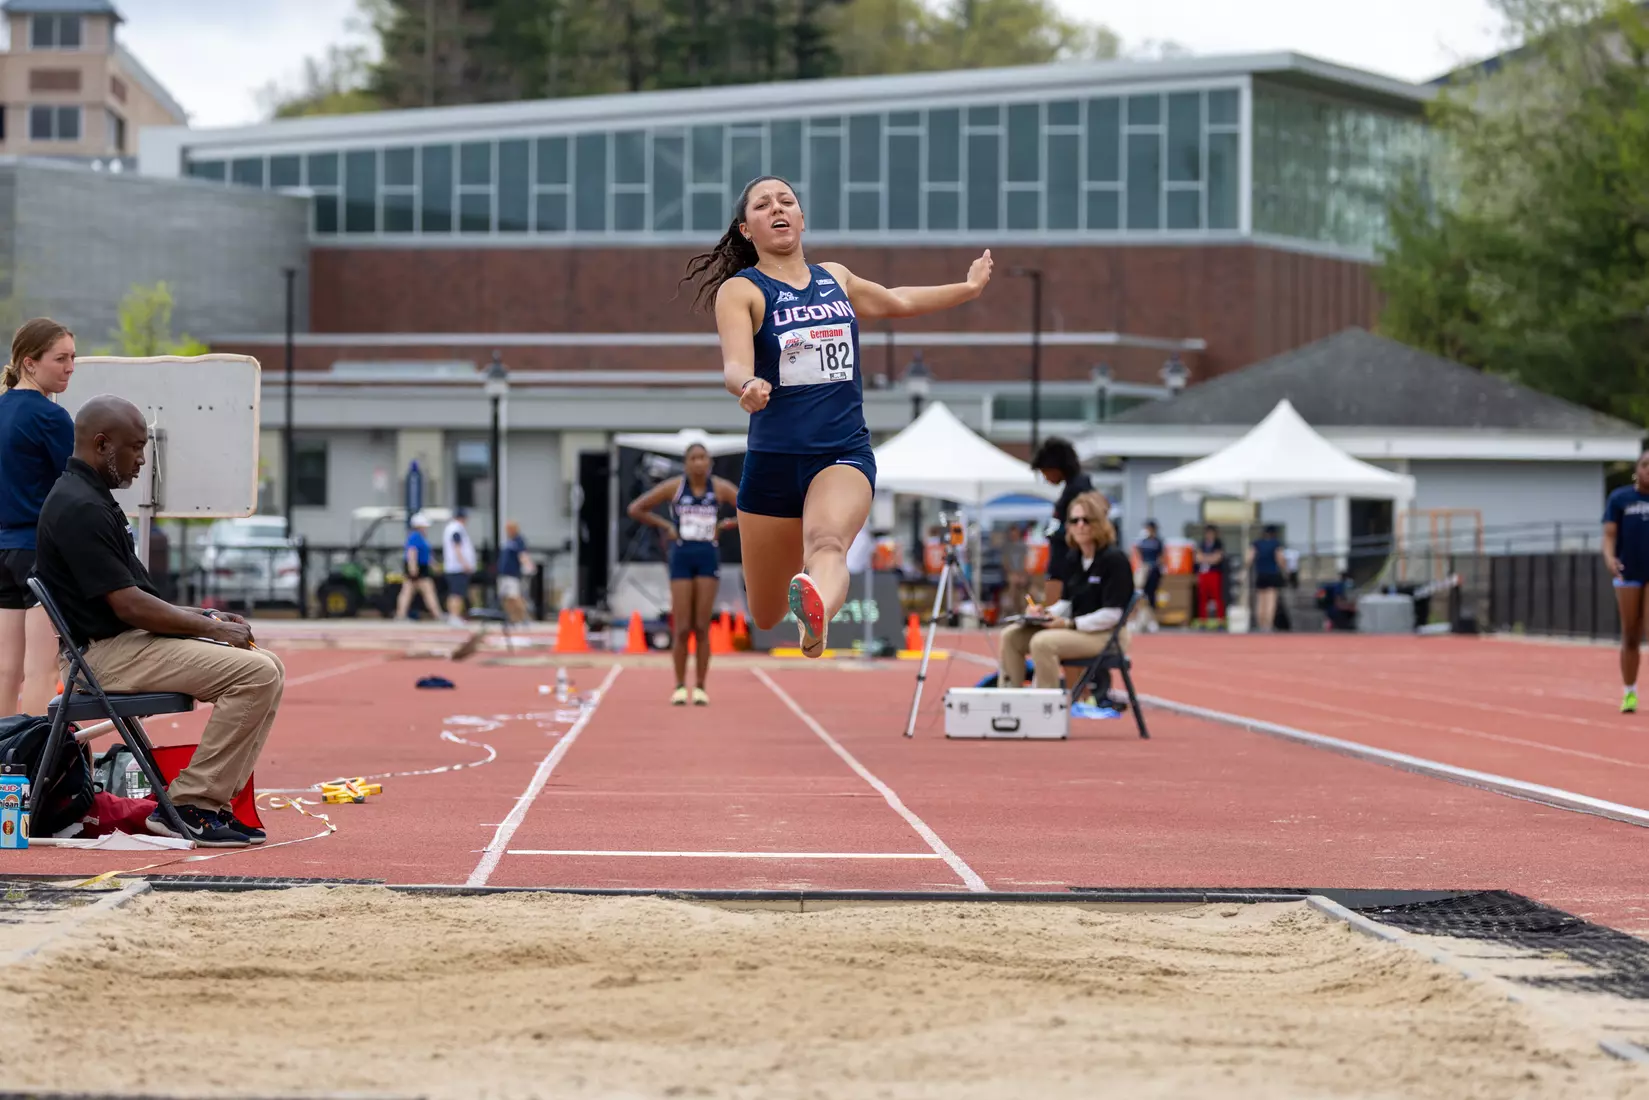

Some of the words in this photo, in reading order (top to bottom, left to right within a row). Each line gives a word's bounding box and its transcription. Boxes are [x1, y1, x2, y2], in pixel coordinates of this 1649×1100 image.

[773, 300, 855, 326] UCONN
[810, 329, 843, 339] Germann
[815, 342, 852, 371] 182
